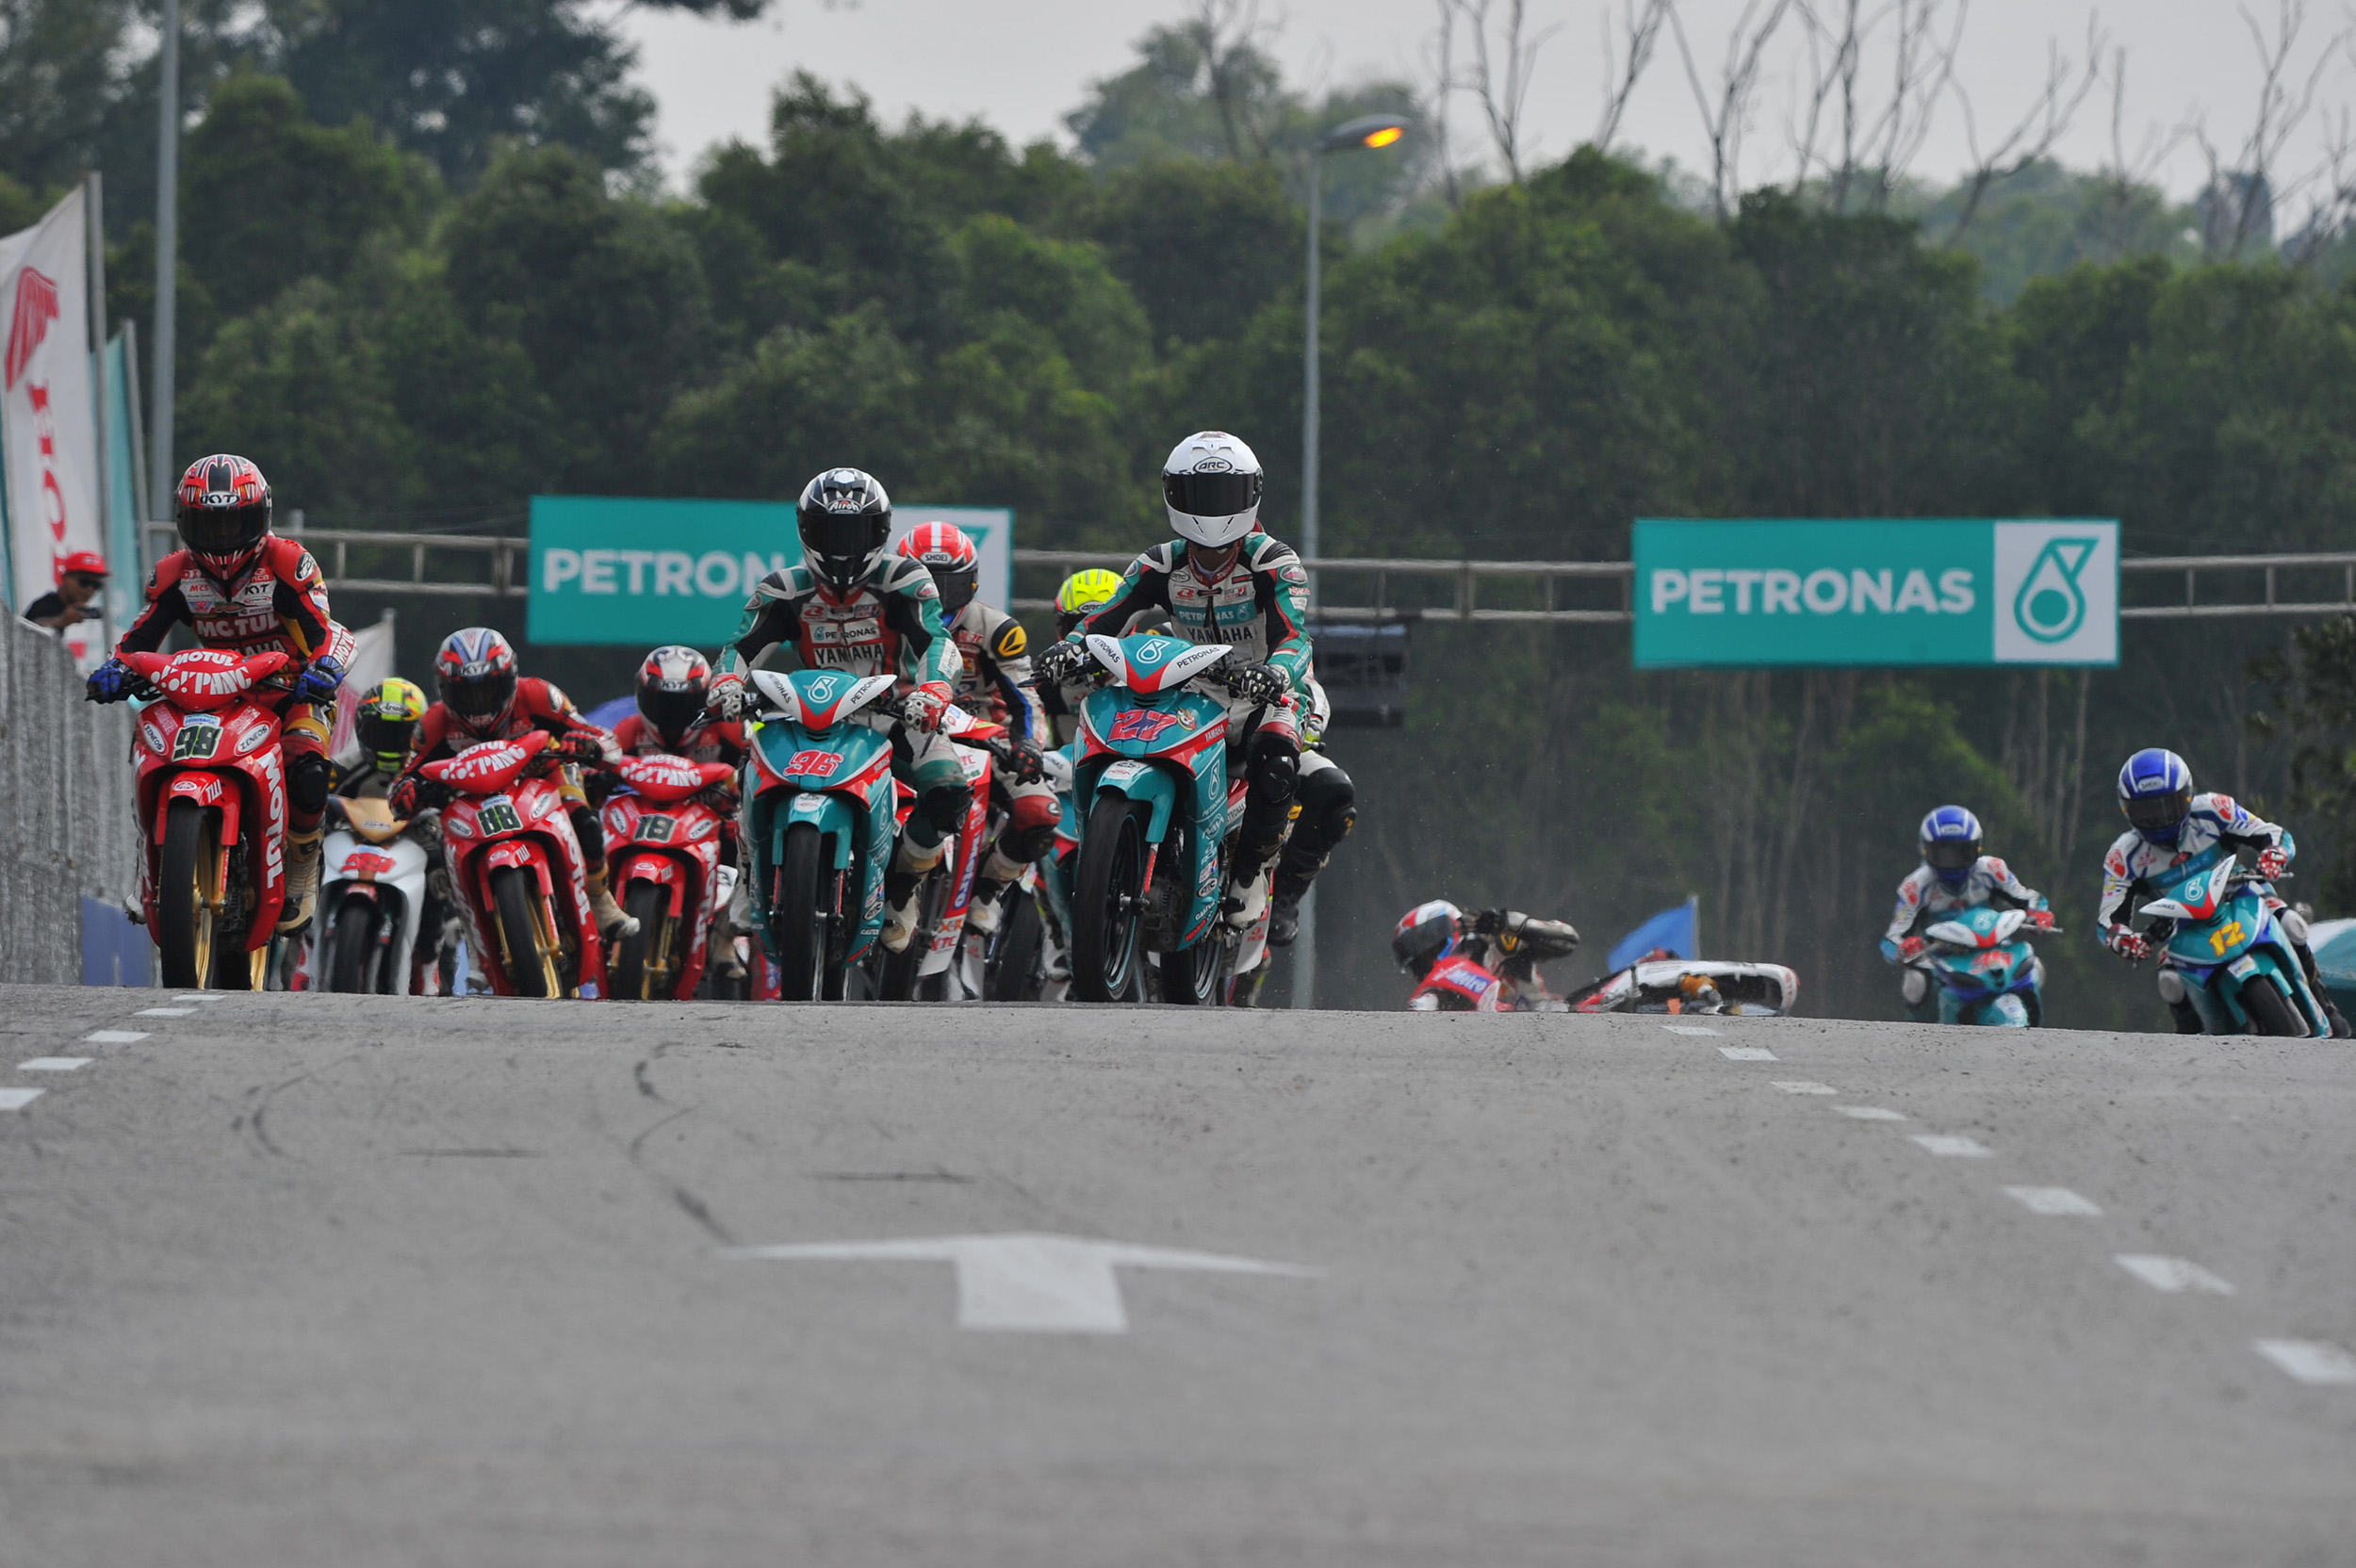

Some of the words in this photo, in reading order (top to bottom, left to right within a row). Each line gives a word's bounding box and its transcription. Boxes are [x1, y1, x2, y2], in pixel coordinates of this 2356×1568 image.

[1199, 461, 1225, 470] ARC
[829, 500, 859, 512] Airoh
[544, 549, 780, 596] PETRON
[245, 583, 270, 596] KYT
[1651, 568, 1976, 614] PETRONAS
[825, 627, 877, 639] PERONAS
[172, 650, 235, 667] MOTUL
[815, 643, 884, 665] YAMAHA
[1091, 636, 1121, 663] PETRONAS
[1176, 646, 1219, 669] PETRONAS
[766, 673, 793, 704] PETRONAS
[851, 676, 881, 705] PETRONAS
[1107, 709, 1178, 744] 27
[173, 725, 223, 761] 98
[783, 749, 843, 776] 96
[255, 750, 284, 889] MOTUL
[475, 804, 524, 837] 88
[546, 808, 591, 926] MOTUL
[693, 841, 719, 954] MOTUL
[2209, 921, 2247, 957] 12
